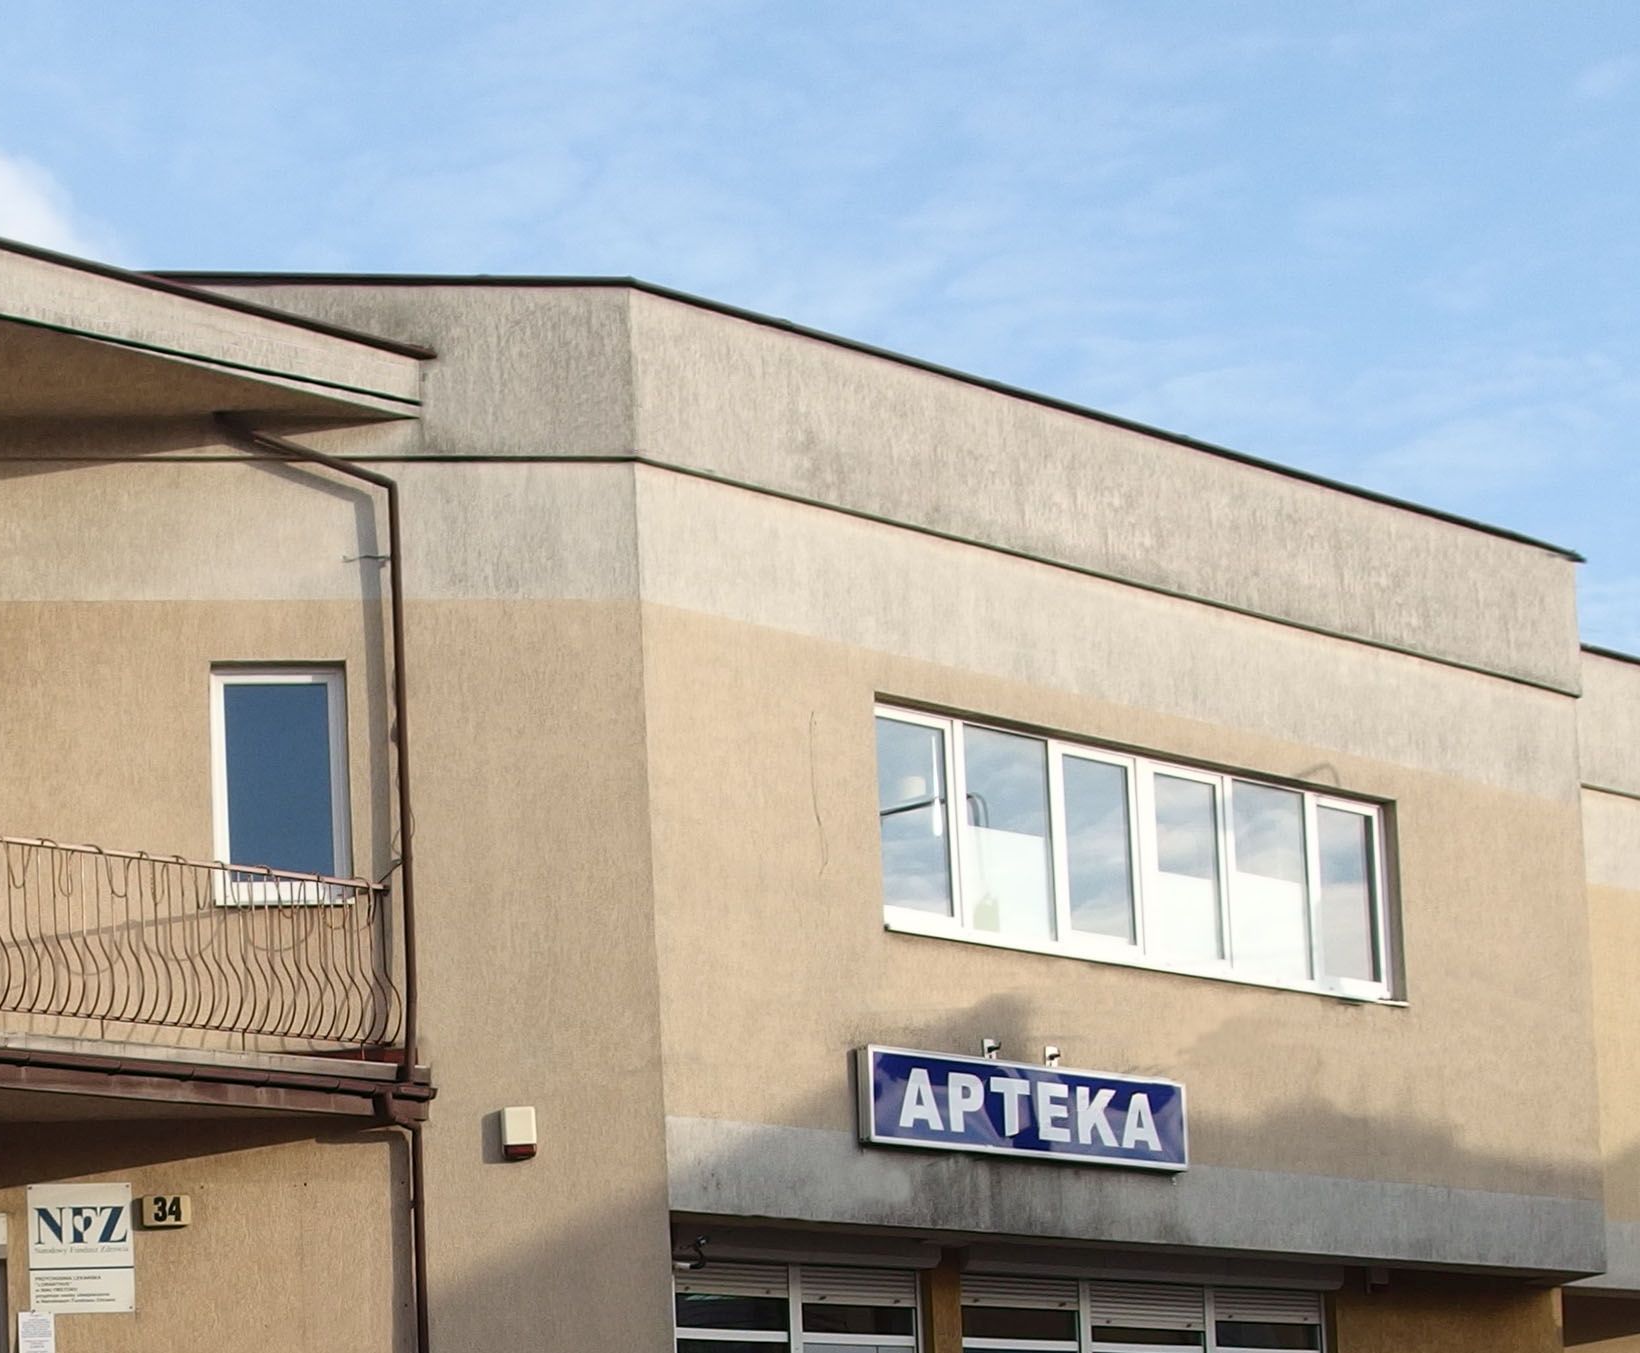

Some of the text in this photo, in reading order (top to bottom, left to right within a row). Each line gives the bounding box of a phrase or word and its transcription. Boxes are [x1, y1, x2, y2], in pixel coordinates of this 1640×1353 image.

[899, 1067, 1162, 1151] APTEKA
[34, 1206, 128, 1245] NFZ
[153, 1196, 182, 1222] 34
